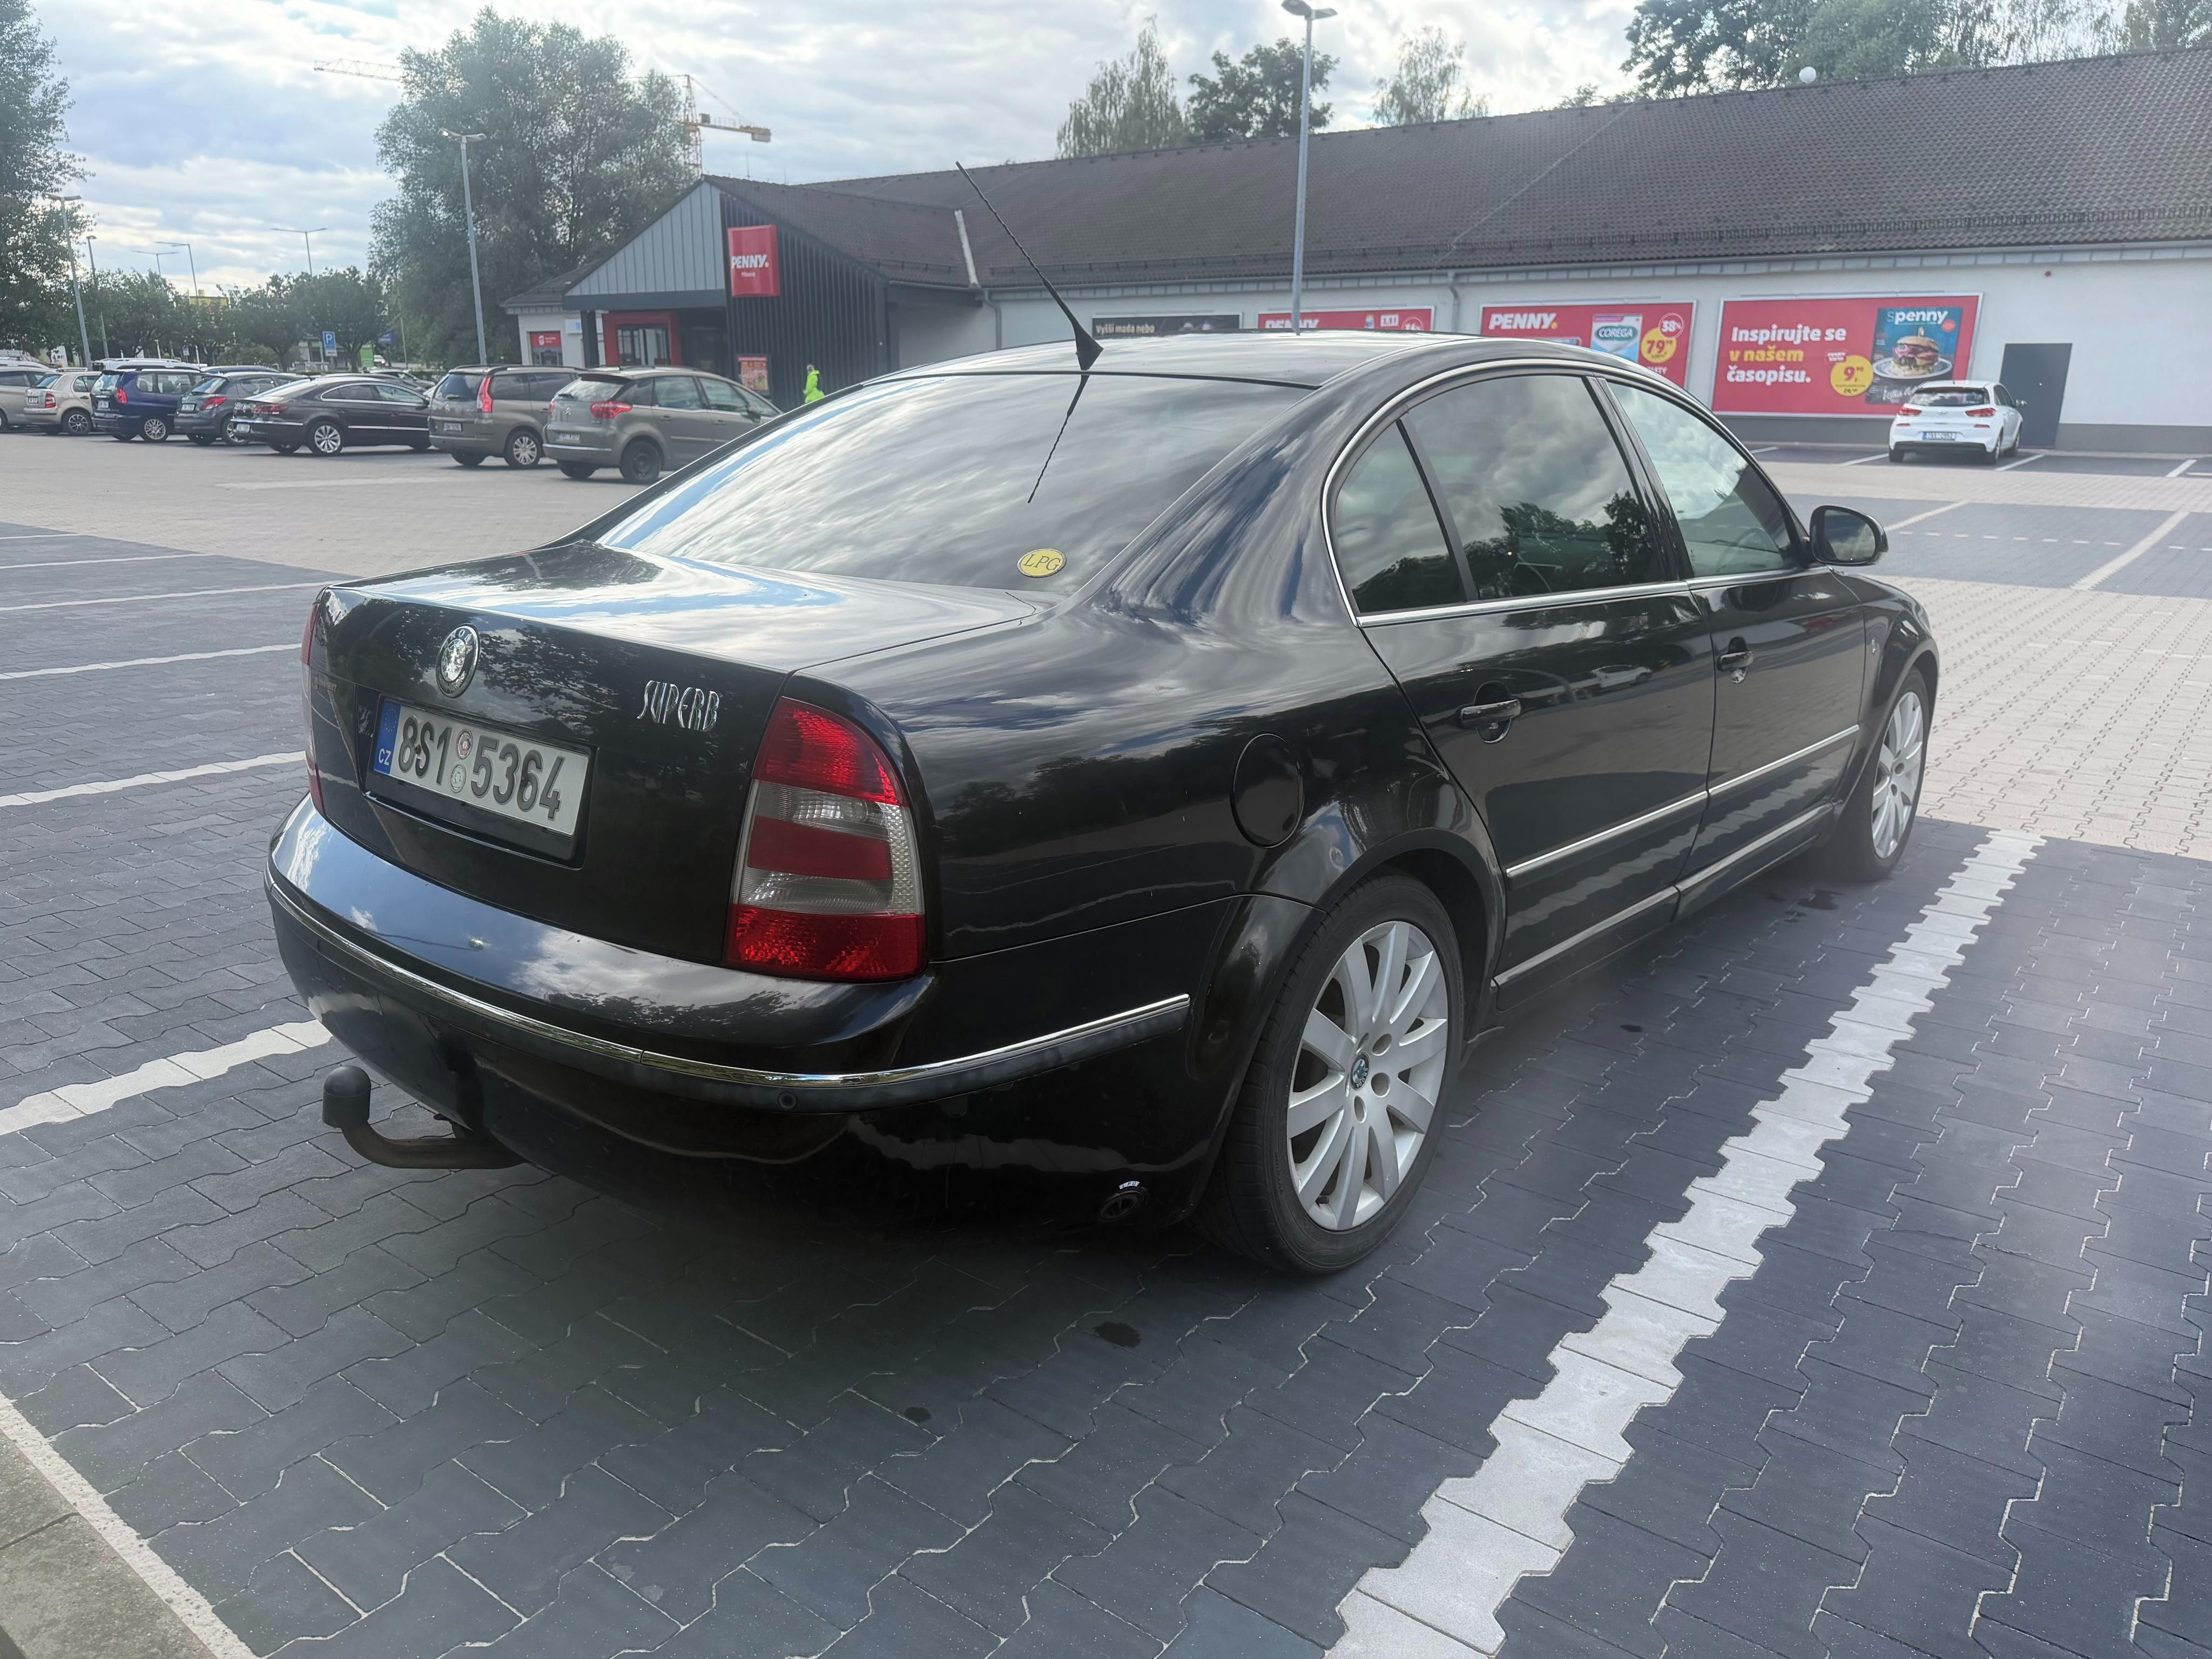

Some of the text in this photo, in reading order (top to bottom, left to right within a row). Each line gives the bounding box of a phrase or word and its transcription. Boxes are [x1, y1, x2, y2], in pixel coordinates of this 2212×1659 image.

[1598, 327, 1633, 338] COREGA
[1731, 323, 1847, 345] Inspirujte se
[1729, 345, 1804, 362] v našem
[1727, 365, 1811, 386] časopisu.
[1844, 367, 1855, 381] 9
[1023, 554, 1062, 571] LPG
[637, 680, 720, 732] SUPERB
[378, 715, 565, 820] CZ 8S1 5364
